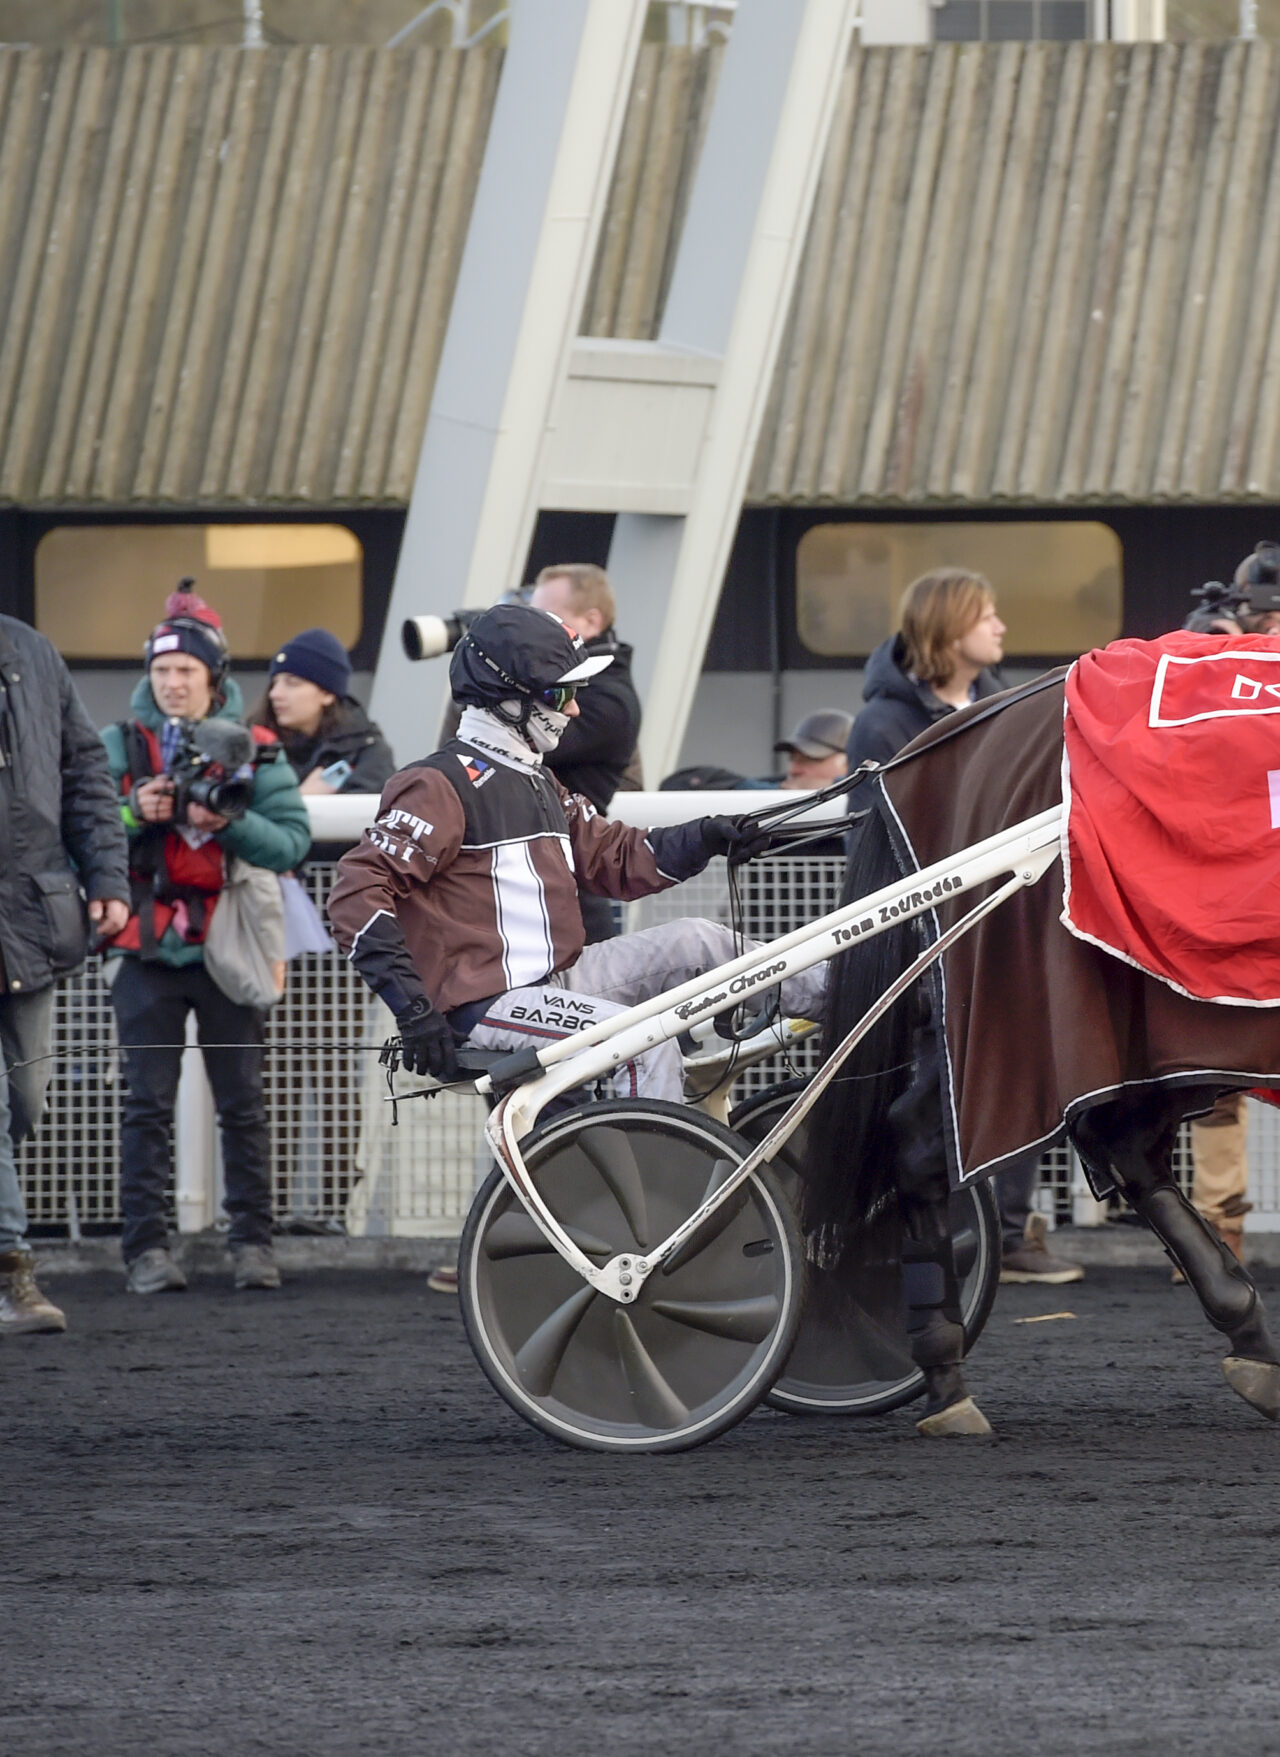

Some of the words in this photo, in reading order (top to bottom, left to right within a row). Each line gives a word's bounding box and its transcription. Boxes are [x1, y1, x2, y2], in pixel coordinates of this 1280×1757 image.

[831, 917, 875, 945] Team
[729, 961, 787, 994] Chrono
[543, 995, 596, 1014] VANS
